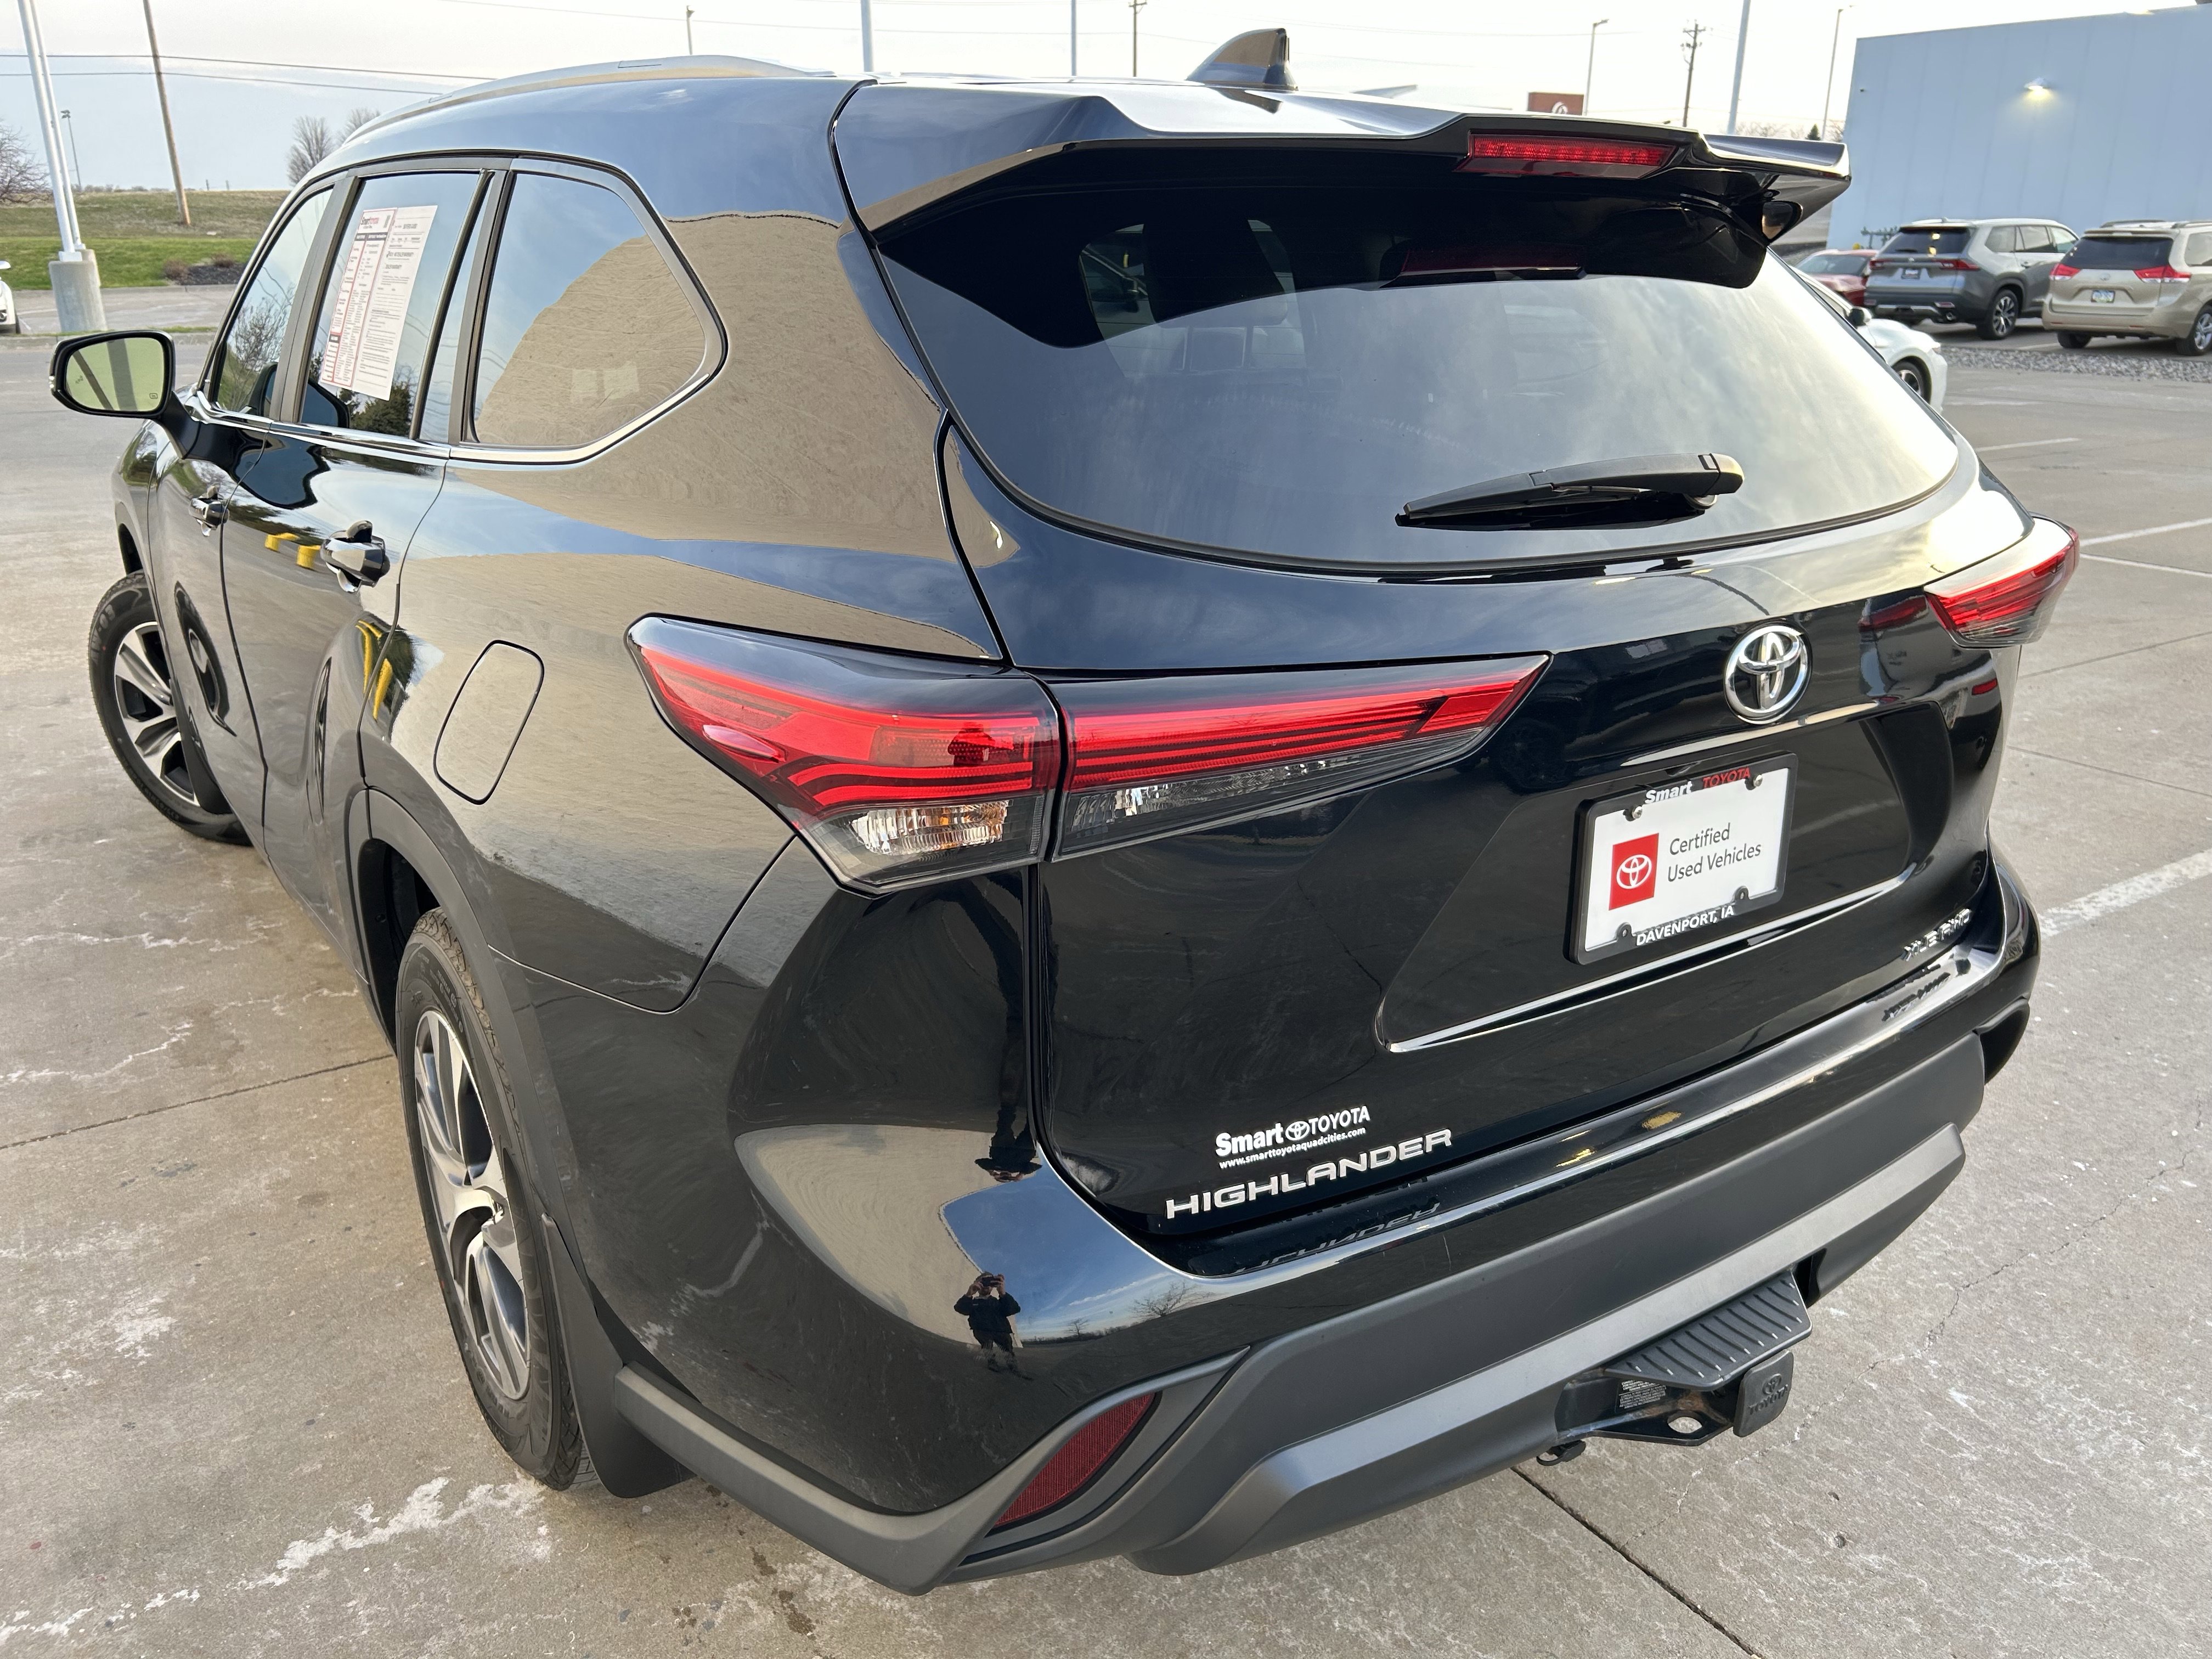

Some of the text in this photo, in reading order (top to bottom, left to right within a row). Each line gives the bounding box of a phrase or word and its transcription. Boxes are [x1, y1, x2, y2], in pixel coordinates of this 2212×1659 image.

[1645, 766, 1751, 804] Smart TOYOTA
[1669, 822, 1731, 855] Certified
[1667, 843, 1762, 882] Used Vehicles
[1636, 905, 1734, 946] DAVENPORT, IA
[1215, 1105, 1370, 1156] Smart TOYOTA
[1219, 1126, 1366, 1170] www.smarttoyotaquadcities.com
[1166, 1128, 1453, 1220] HIGHLANDER
[1748, 1384, 1790, 1415] TOYOTA
